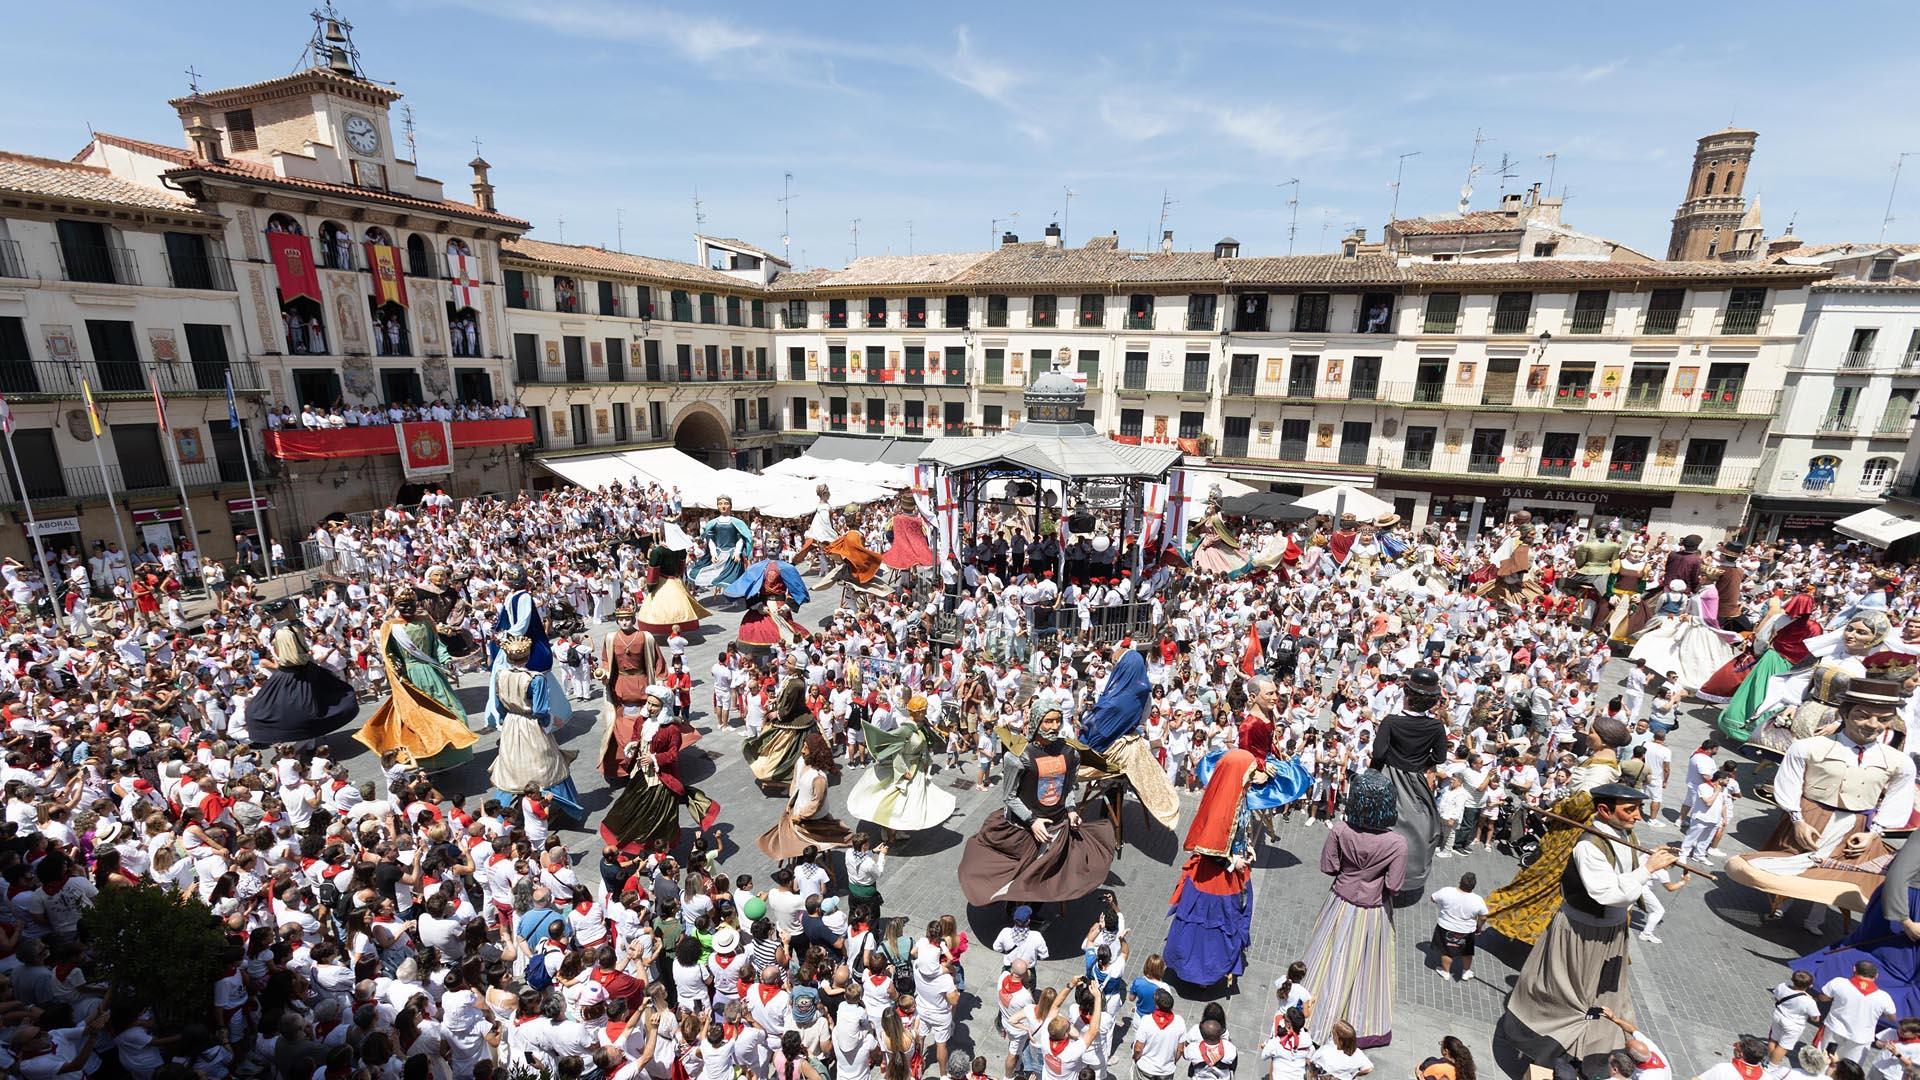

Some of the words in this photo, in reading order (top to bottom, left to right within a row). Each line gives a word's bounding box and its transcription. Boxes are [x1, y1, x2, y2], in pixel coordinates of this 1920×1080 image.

[1502, 487, 1533, 498] BAR
[1544, 490, 1609, 503] ARAGON
[37, 520, 75, 529] ABORAL
